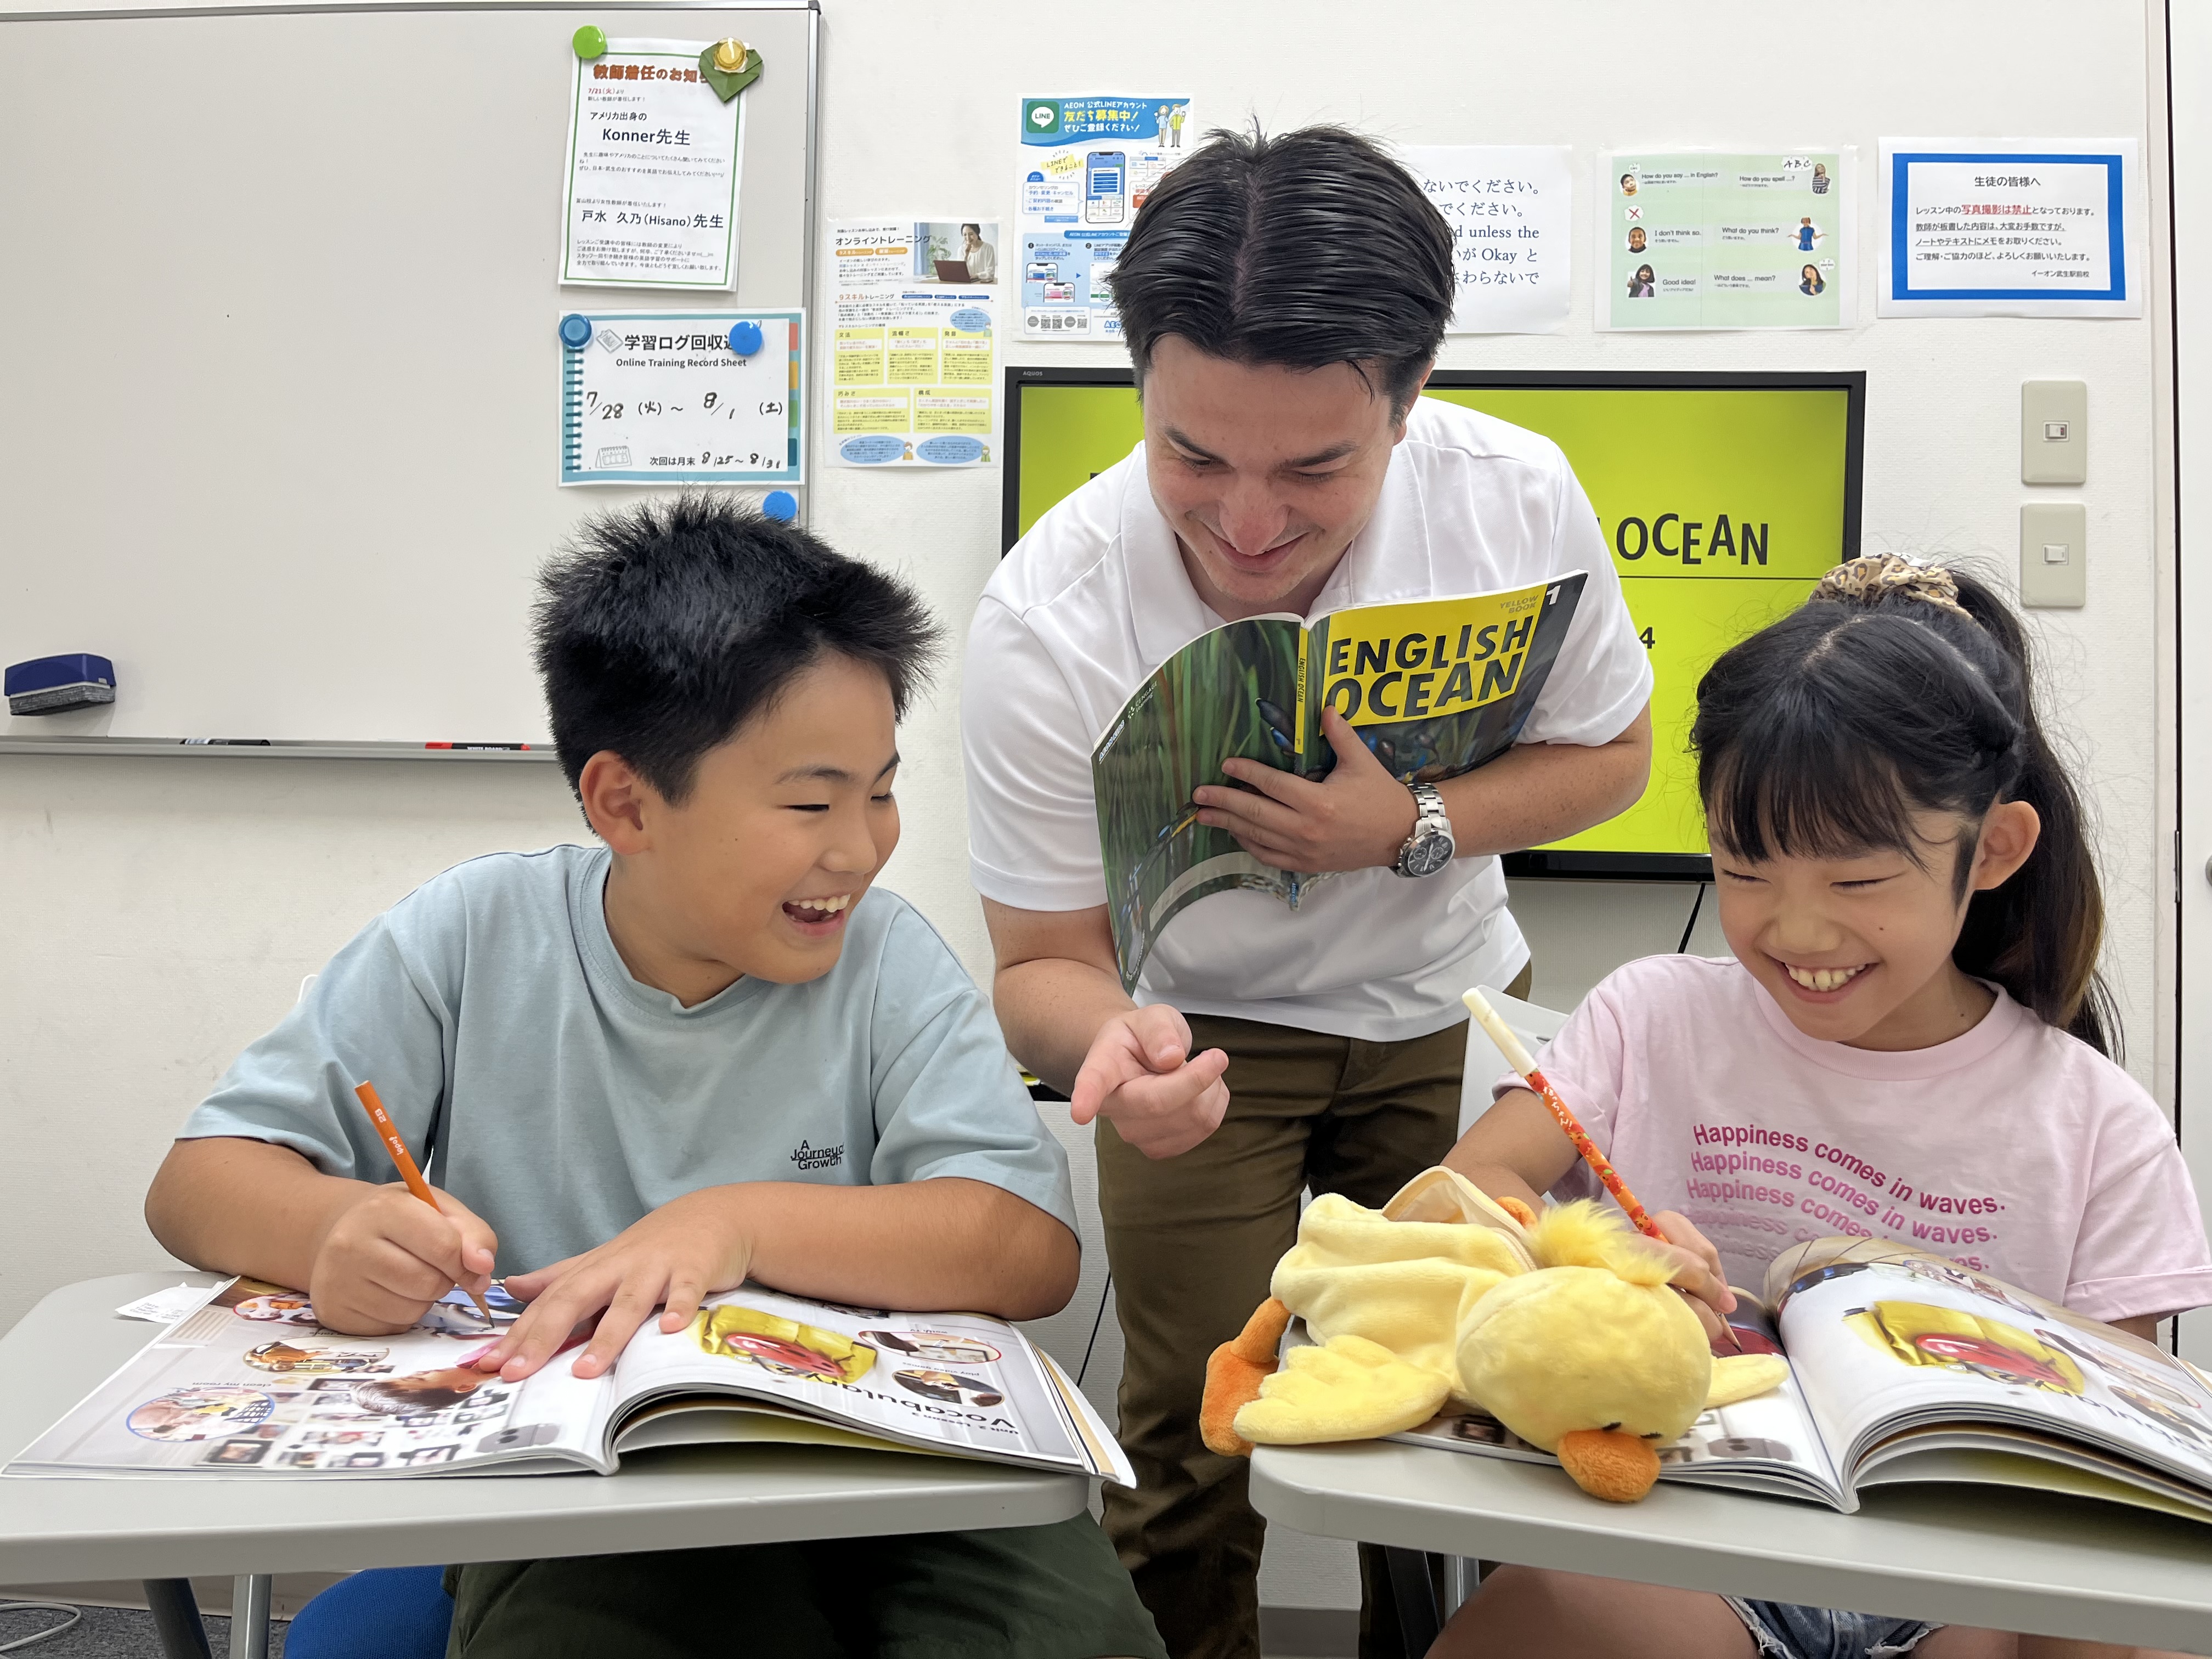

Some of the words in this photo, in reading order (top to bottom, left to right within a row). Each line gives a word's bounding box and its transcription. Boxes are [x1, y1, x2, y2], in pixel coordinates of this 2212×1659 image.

[590, 111, 647, 121] アメリカ出身の
[1064, 110, 1138, 122] 友だち募集中！
[1064, 123, 1141, 133] ぜひご登録ください！
[602, 128, 691, 146] Konner先生
[1423, 179, 1538, 194] ないでください。
[1974, 176, 2041, 187] 生徒の皆様へ
[582, 210, 607, 223] 戸水
[1439, 202, 1522, 217] でください。
[1916, 204, 2095, 216] レッスン中の写真撮影は禁止となっております。
[1469, 225, 1511, 238] unless
[1518, 226, 1540, 238] the
[836, 235, 932, 246] オンライントレーニング
[1915, 237, 2062, 246] ノートやテキストにメモをお取りください。
[1482, 248, 1517, 264] Okay
[1527, 248, 1537, 262] と
[1916, 252, 2090, 262] ご理解・ご協力のほど、よろしくお願いいたします。
[2032, 270, 2090, 278] イーオン武生駅前校
[616, 358, 646, 367] Online
[648, 358, 685, 369] Training
[687, 358, 719, 367] Record
[721, 358, 747, 367] Sheet
[650, 457, 696, 466] 次回は月末
[1616, 513, 1769, 565] OCEAN
[1499, 594, 1539, 609] YELLOW
[1545, 584, 1561, 606] 1
[1508, 602, 1537, 614] BOOK
[1328, 616, 1534, 676] ENGLISH
[1639, 627, 1656, 650] 4
[1297, 657, 1306, 681] ENGLISH
[1135, 680, 1158, 707] CENGAGE
[1324, 652, 1522, 721] OCEAN
[374, 1108, 387, 1123] 2B
[800, 1139, 810, 1150] A
[790, 1146, 838, 1161] Journey
[798, 1155, 842, 1170] Growth
[1693, 1123, 1809, 1153] Happiness
[1814, 1142, 1887, 1188] comes
[1889, 1177, 1914, 1202] in
[1920, 1192, 2006, 1215] waves.
[1685, 1178, 1795, 1208] Happiness
[1690, 1150, 1802, 1180] Happiness
[1808, 1170, 1880, 1216] comes
[1881, 1204, 1905, 1231] in
[1912, 1220, 1999, 1244] waves.
[805, 1373, 1017, 1429] Vocabulary
[923, 1414, 971, 1426] Lesson
